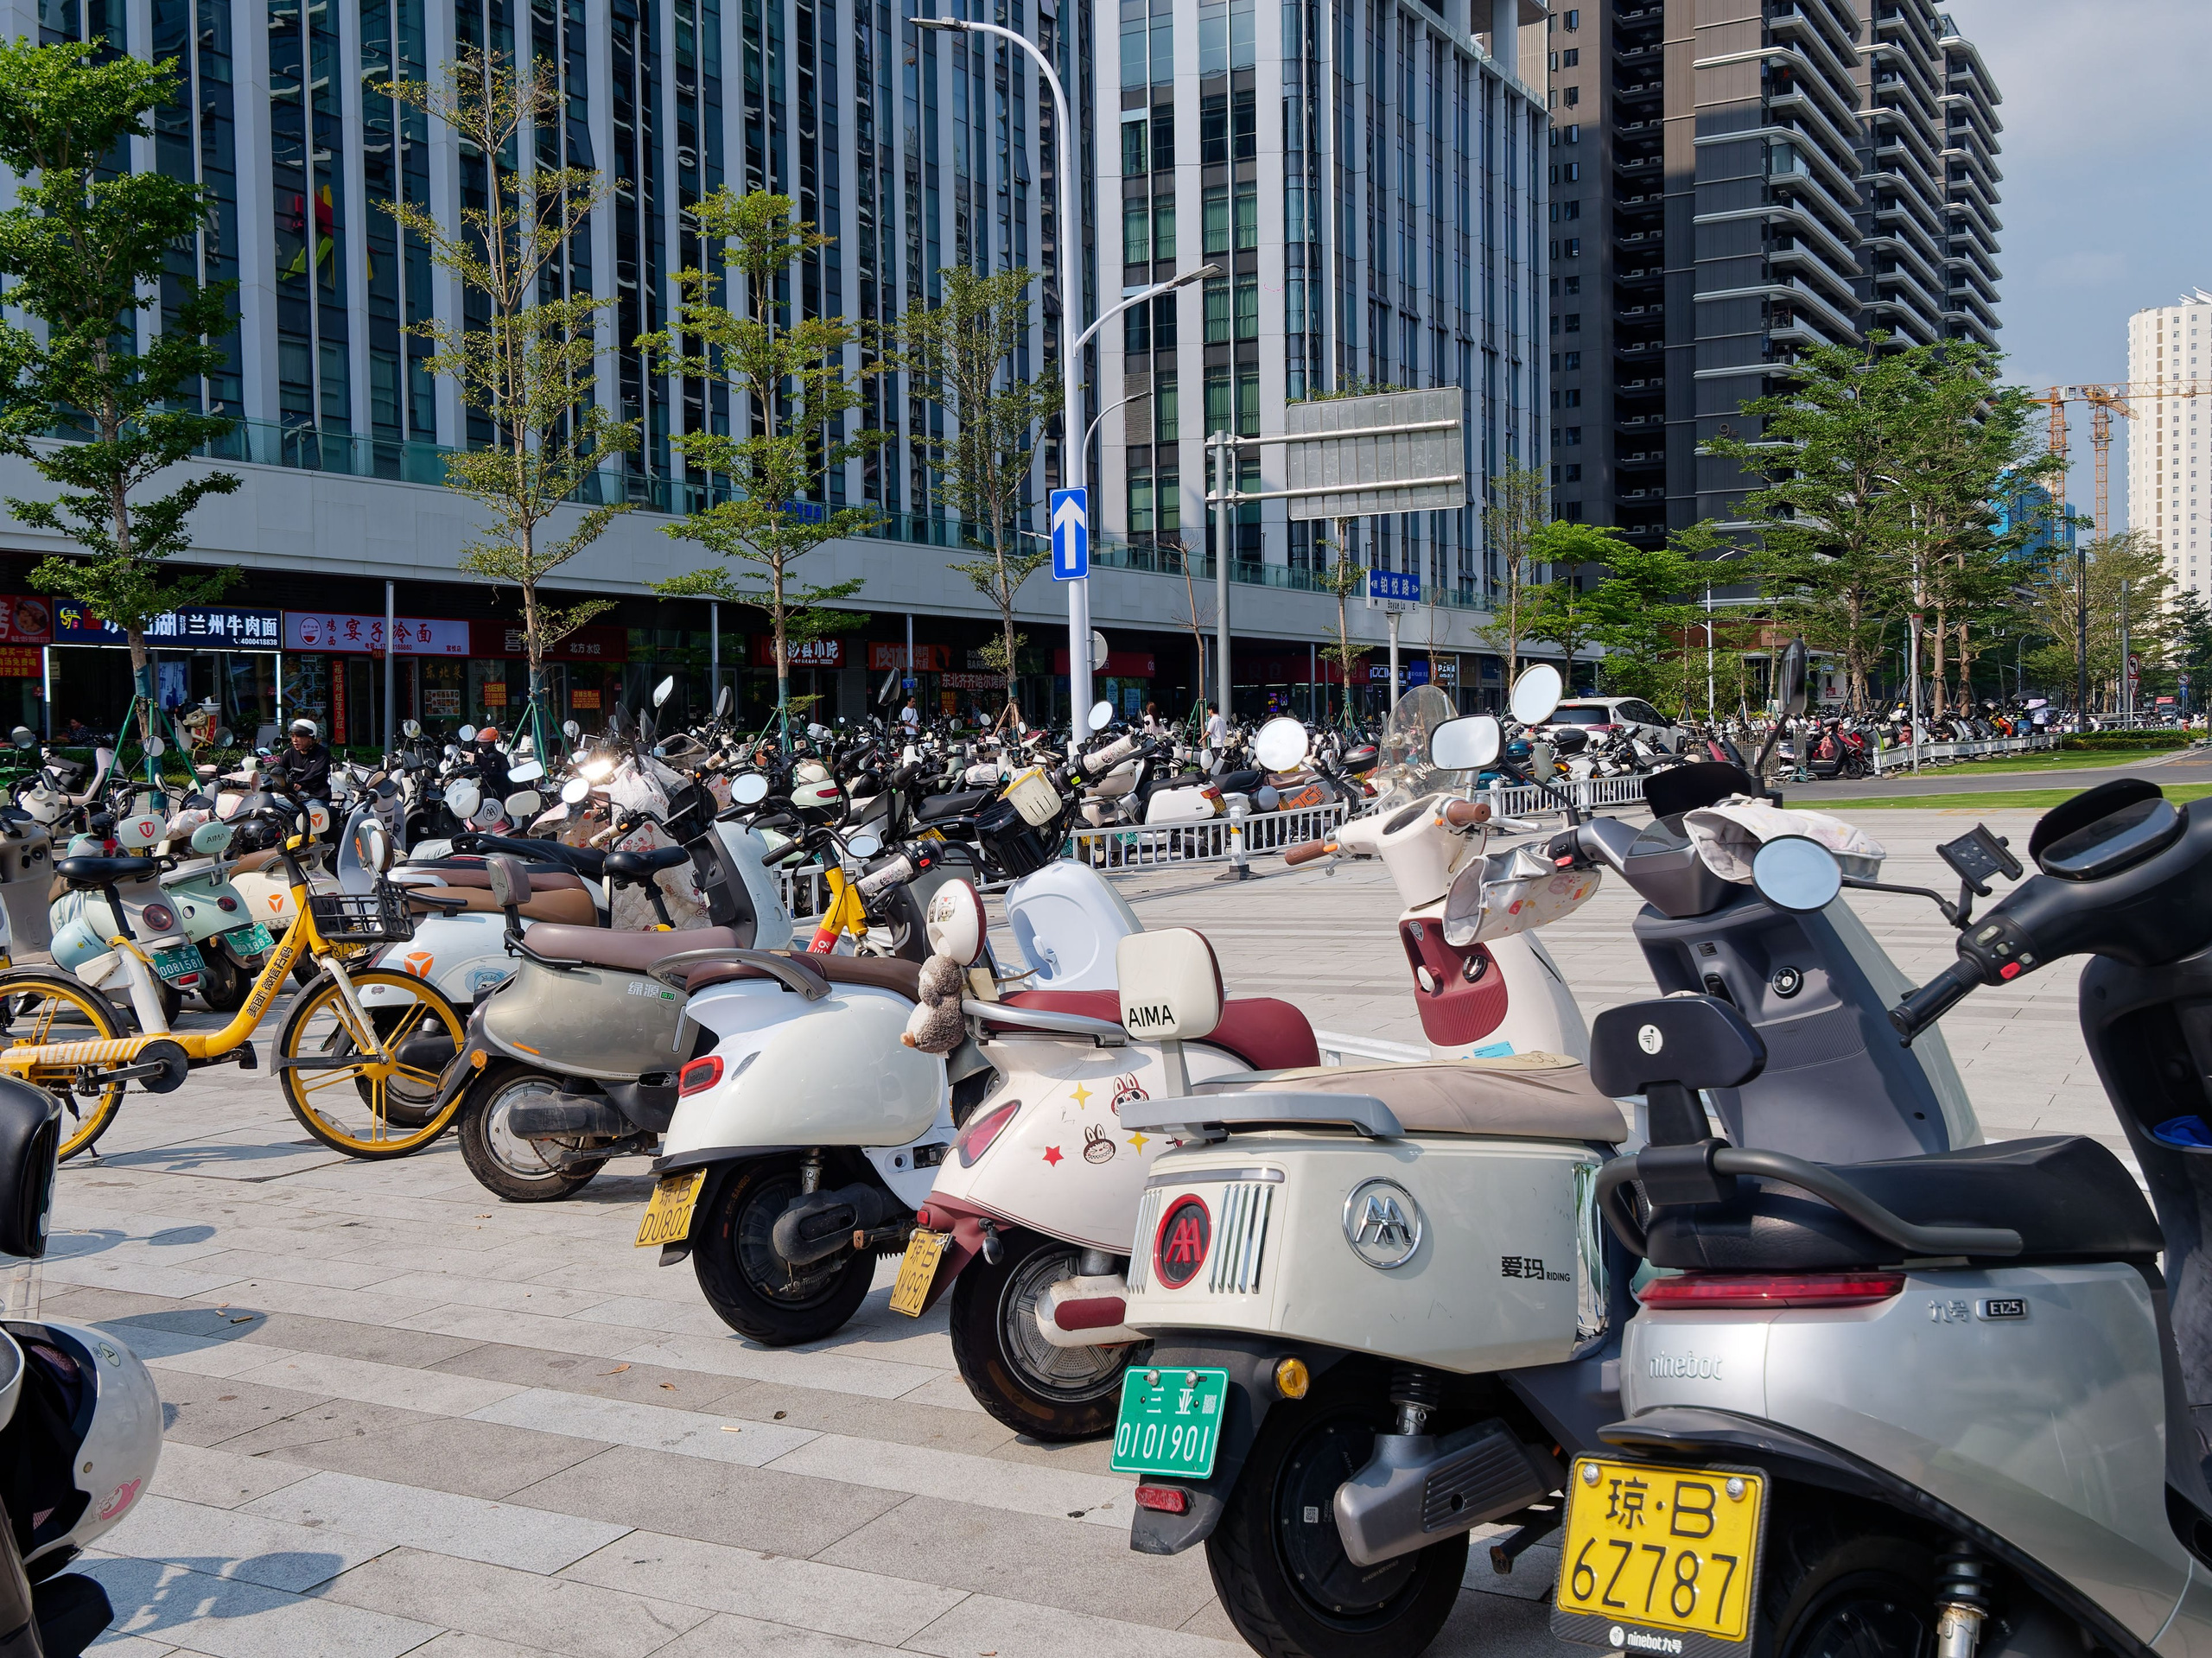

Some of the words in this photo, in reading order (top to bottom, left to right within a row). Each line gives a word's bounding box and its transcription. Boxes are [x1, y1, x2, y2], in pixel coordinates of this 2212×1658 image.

[189, 613, 277, 637] 兰州牛肉面
[942, 672, 1007, 689] 东北齐齐哈尔烤肉
[207, 833, 226, 843] AIMA
[627, 981, 659, 999] 绿源
[246, 990, 266, 1018] 美团
[1128, 1005, 1176, 1028] AIMA
[1502, 1256, 1545, 1280] 爱玛
[1547, 1273, 1571, 1282] RIDING
[1929, 1300, 1970, 1323] 九号
[1990, 1302, 2021, 1316] E125
[1649, 1351, 1723, 1379] ninebot
[1147, 1387, 1194, 1414] 三亚
[1117, 1422, 1210, 1463] 0101901
[1605, 1477, 1718, 1540] 琼·B
[1572, 1537, 1738, 1625] 6Z787
